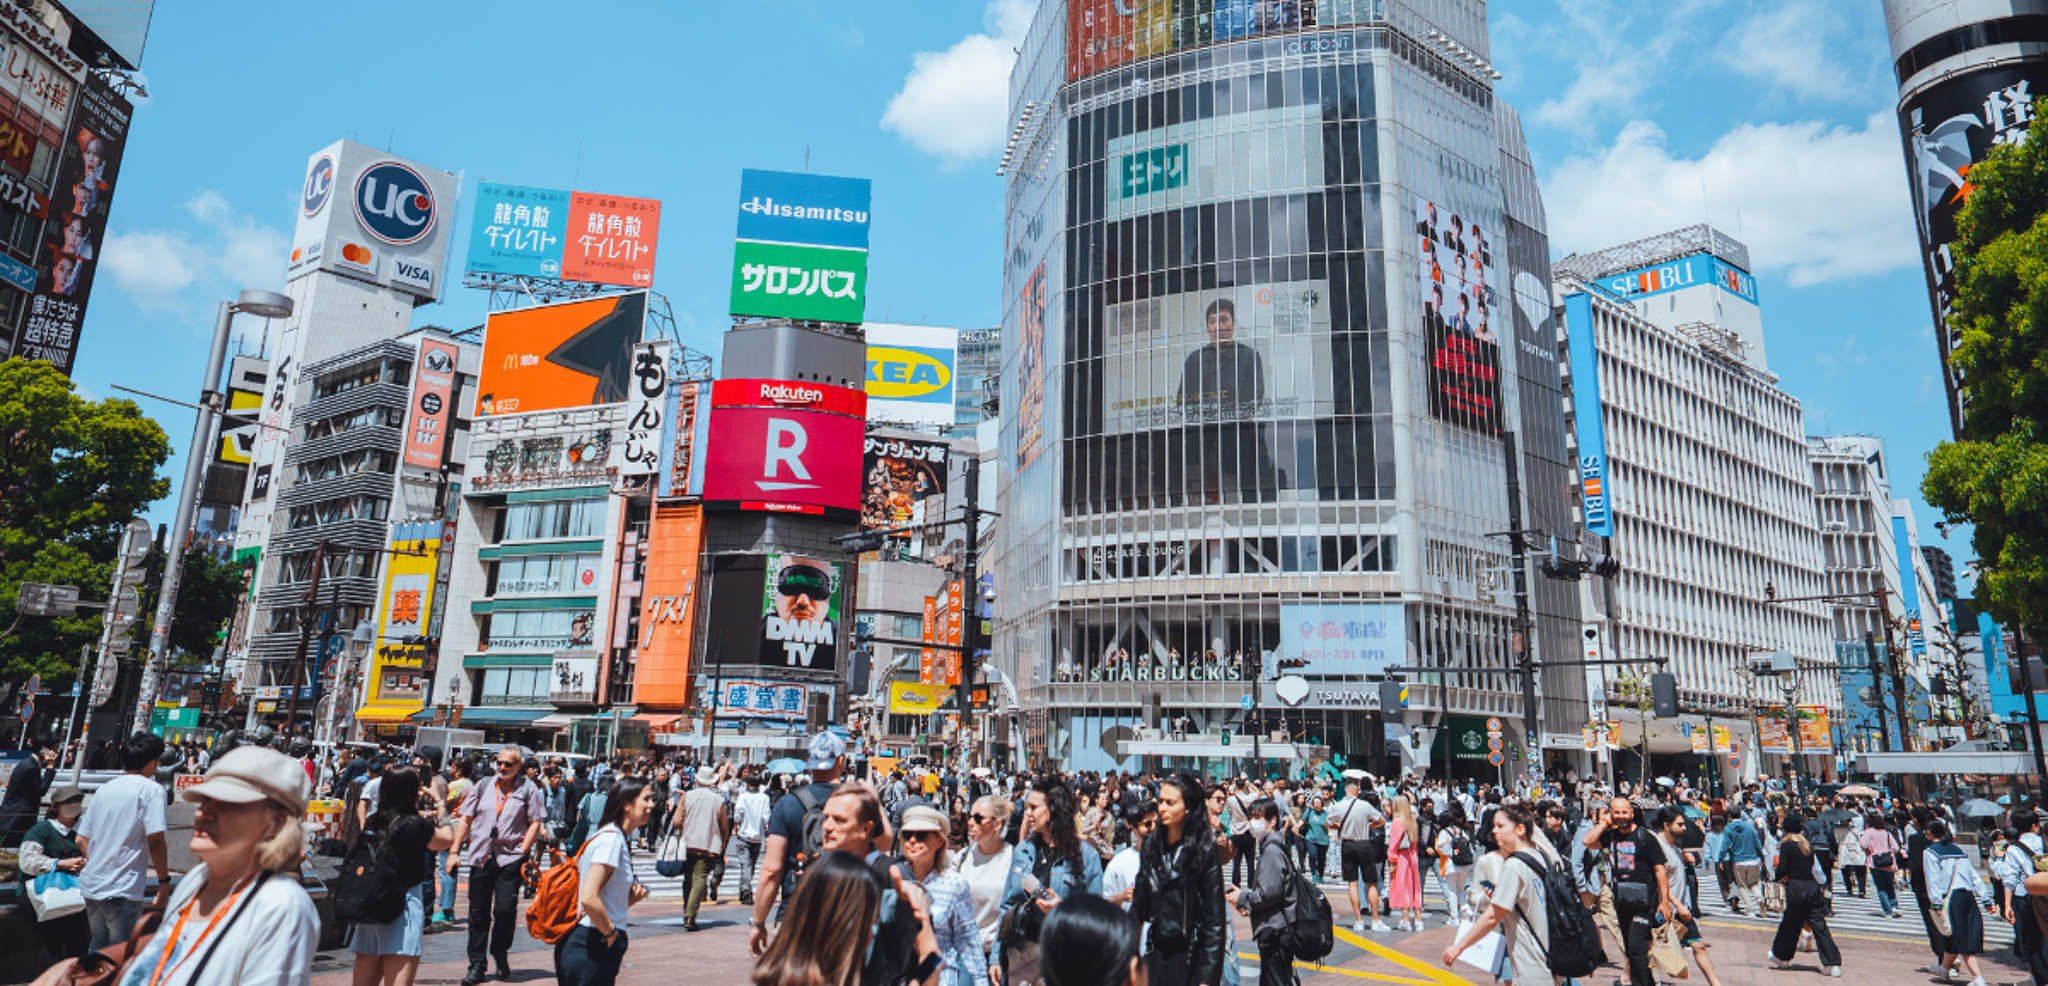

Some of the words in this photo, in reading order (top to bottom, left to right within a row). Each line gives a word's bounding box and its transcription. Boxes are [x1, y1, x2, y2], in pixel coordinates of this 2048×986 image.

[1288, 37, 1349, 54] QFRONT
[8, 49, 69, 112] しゃぶ葉
[307, 168, 331, 200] UC
[1127, 155, 1181, 187] ニトリ
[364, 176, 426, 226] UC
[494, 202, 550, 228] 龍角散
[741, 196, 867, 223] Hisamitsu
[484, 226, 557, 252] ダイレクト
[588, 212, 642, 238] 龍角散
[578, 235, 649, 261] ダイレクト
[397, 262, 430, 282] VISA
[742, 263, 856, 299] サロンパス
[1612, 261, 1694, 297] SEIBU
[1716, 262, 1755, 302] SEIBU
[24, 315, 74, 348] 超特急
[1520, 340, 1554, 362] TSUTAYA
[866, 360, 941, 386] KEA
[626, 344, 666, 470] もんじゃ
[761, 384, 822, 402] Rakuten
[764, 418, 813, 480] R
[863, 438, 945, 463] ダンジョン飯
[1582, 455, 1606, 529] SEIBU
[391, 588, 421, 625] 薬
[643, 581, 693, 649] クスリ
[949, 583, 960, 635] カラオケ
[766, 616, 834, 645] DMM
[783, 642, 816, 666] TV
[1090, 666, 1240, 682] STARBUCKS
[707, 686, 806, 712] 大盛堂書
[1317, 690, 1378, 701] TSUTAYA
